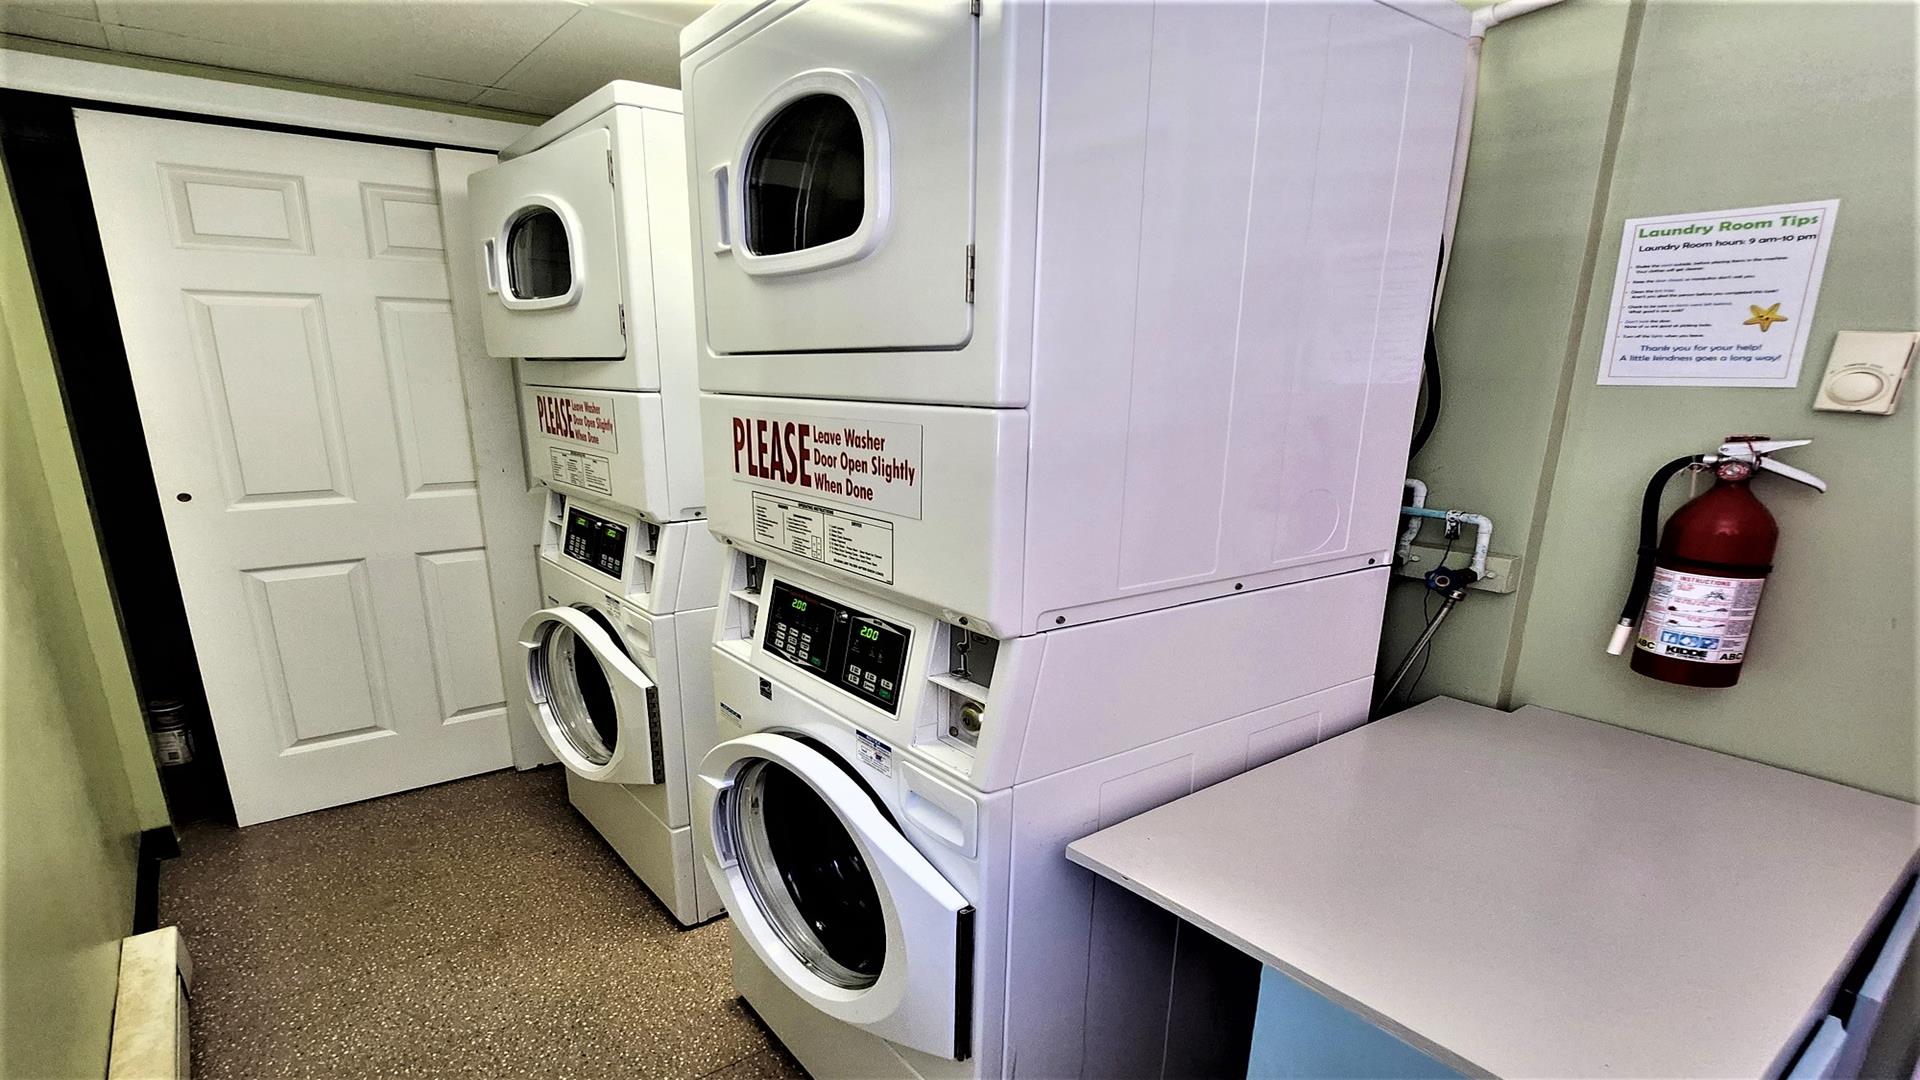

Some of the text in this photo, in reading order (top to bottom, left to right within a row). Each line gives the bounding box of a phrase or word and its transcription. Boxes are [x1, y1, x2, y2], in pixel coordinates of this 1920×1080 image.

[1639, 214, 1819, 239] Laundry Room Tips
[1639, 243, 1680, 252] Laundry
[1683, 241, 1712, 249] Room
[1715, 239, 1745, 247] hours:
[1758, 234, 1794, 244] am-10
[1797, 233, 1817, 242] pm
[1736, 344, 1763, 352] help!
[1755, 354, 1782, 362] way!
[571, 400, 601, 414] Leave Washer
[536, 395, 575, 439] PLEASE
[572, 413, 613, 435] Door Open Slightly
[575, 429, 599, 444] When Done
[813, 425, 885, 452] Leave Washer
[733, 417, 811, 488] PLEASE
[814, 448, 916, 486] Door Open Slightly
[814, 472, 874, 501] When Done
[1680, 576, 1730, 586] INSTRUCTIONS
[791, 598, 807, 612] 2.00
[860, 626, 879, 641] 2.00
[1666, 645, 1708, 658] KIDDE
[1720, 652, 1743, 660] ABC
